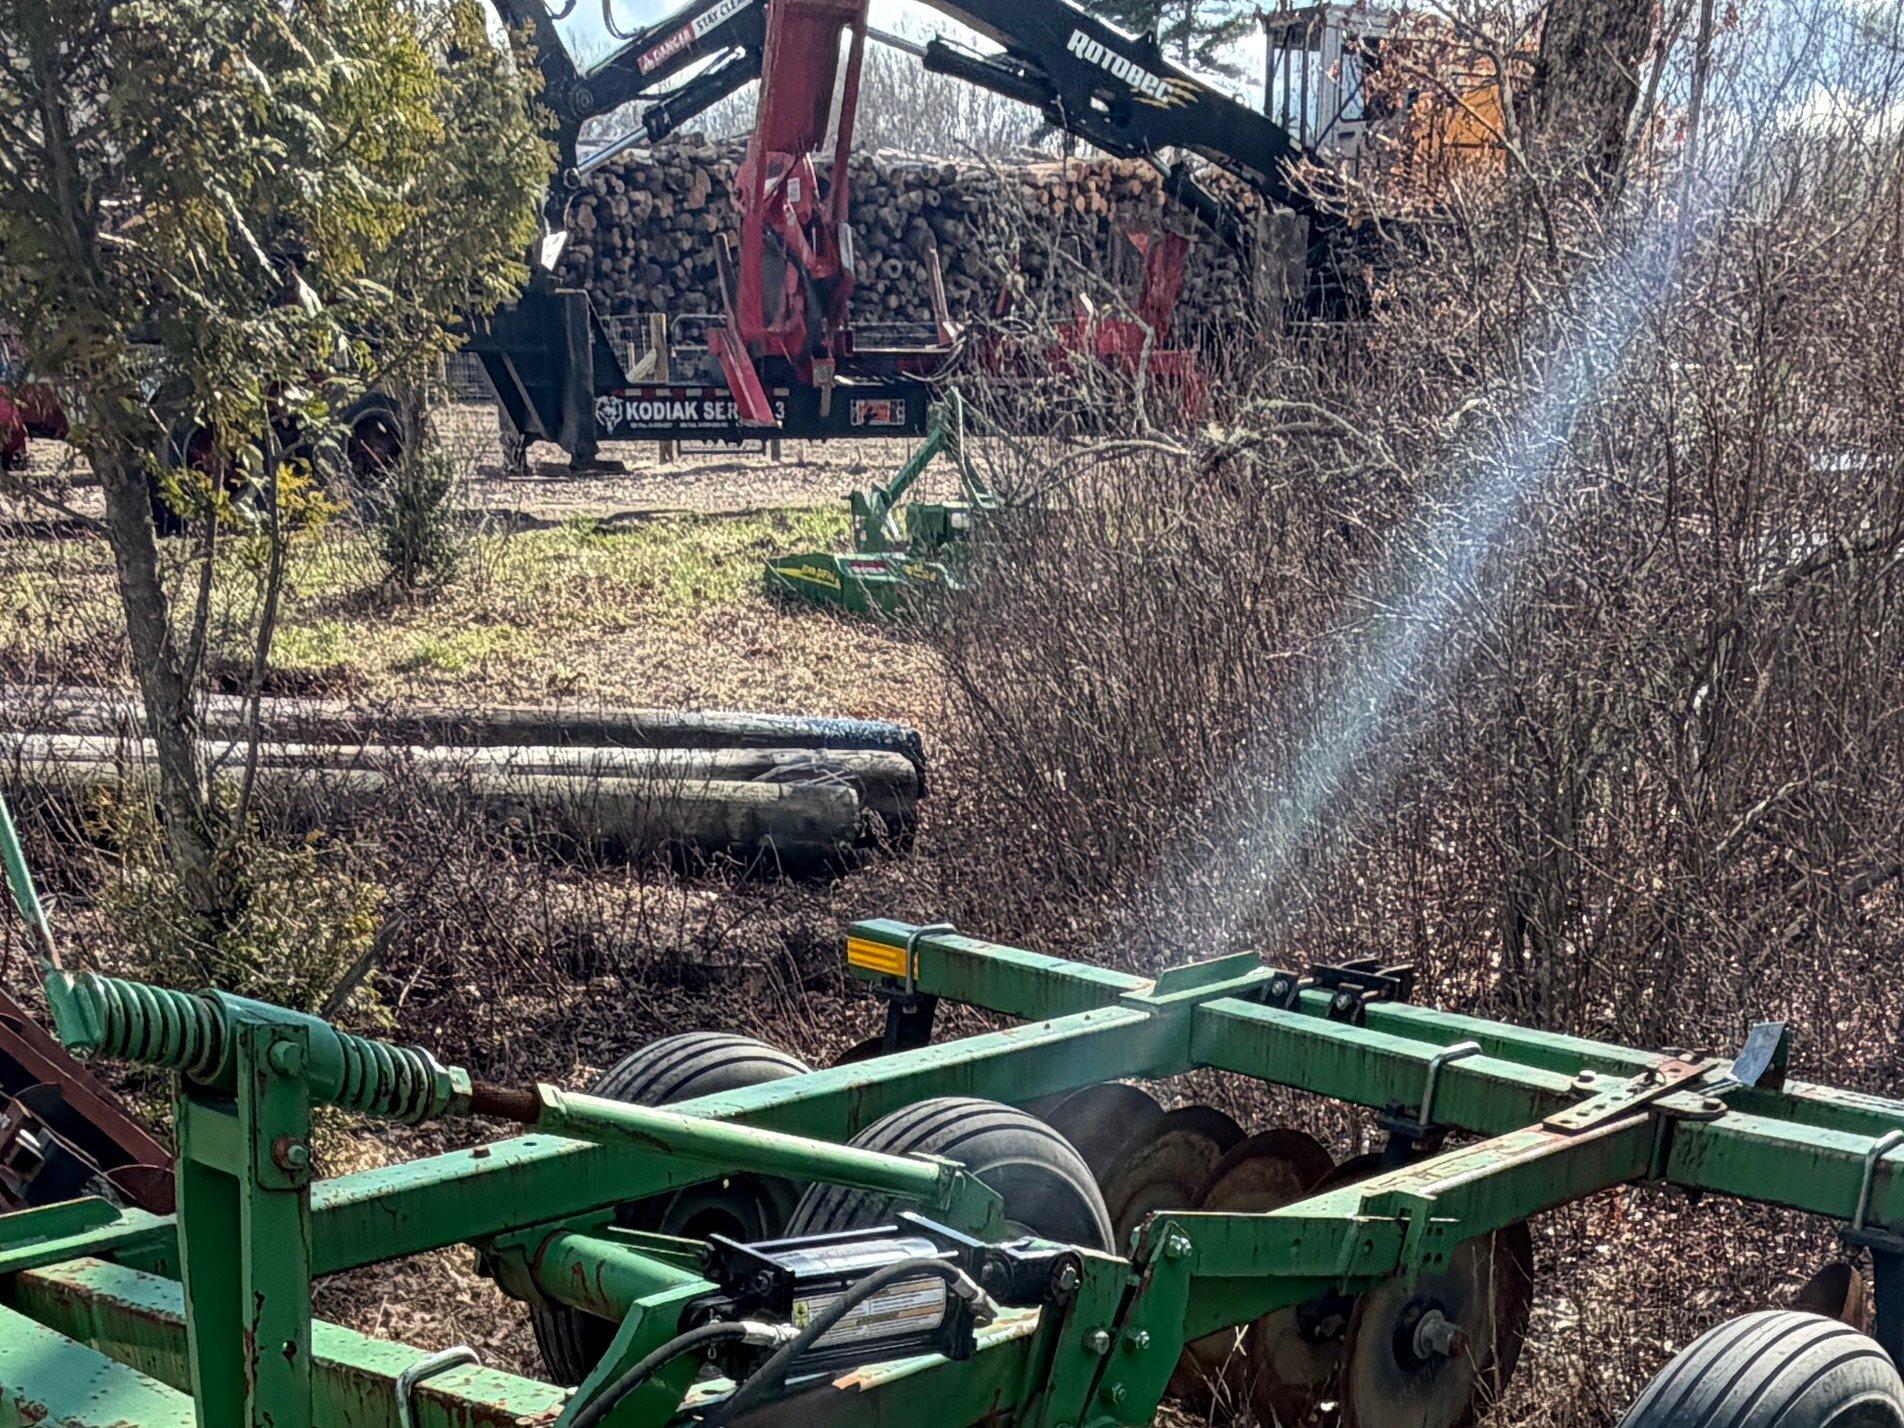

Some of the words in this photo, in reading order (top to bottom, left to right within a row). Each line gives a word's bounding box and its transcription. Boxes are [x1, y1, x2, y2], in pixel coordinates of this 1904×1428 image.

[696, 10, 718, 32] STAY
[1066, 28, 1174, 104] ROTOBEC
[626, 401, 698, 420] KODIAK
[775, 402, 785, 419] 3
